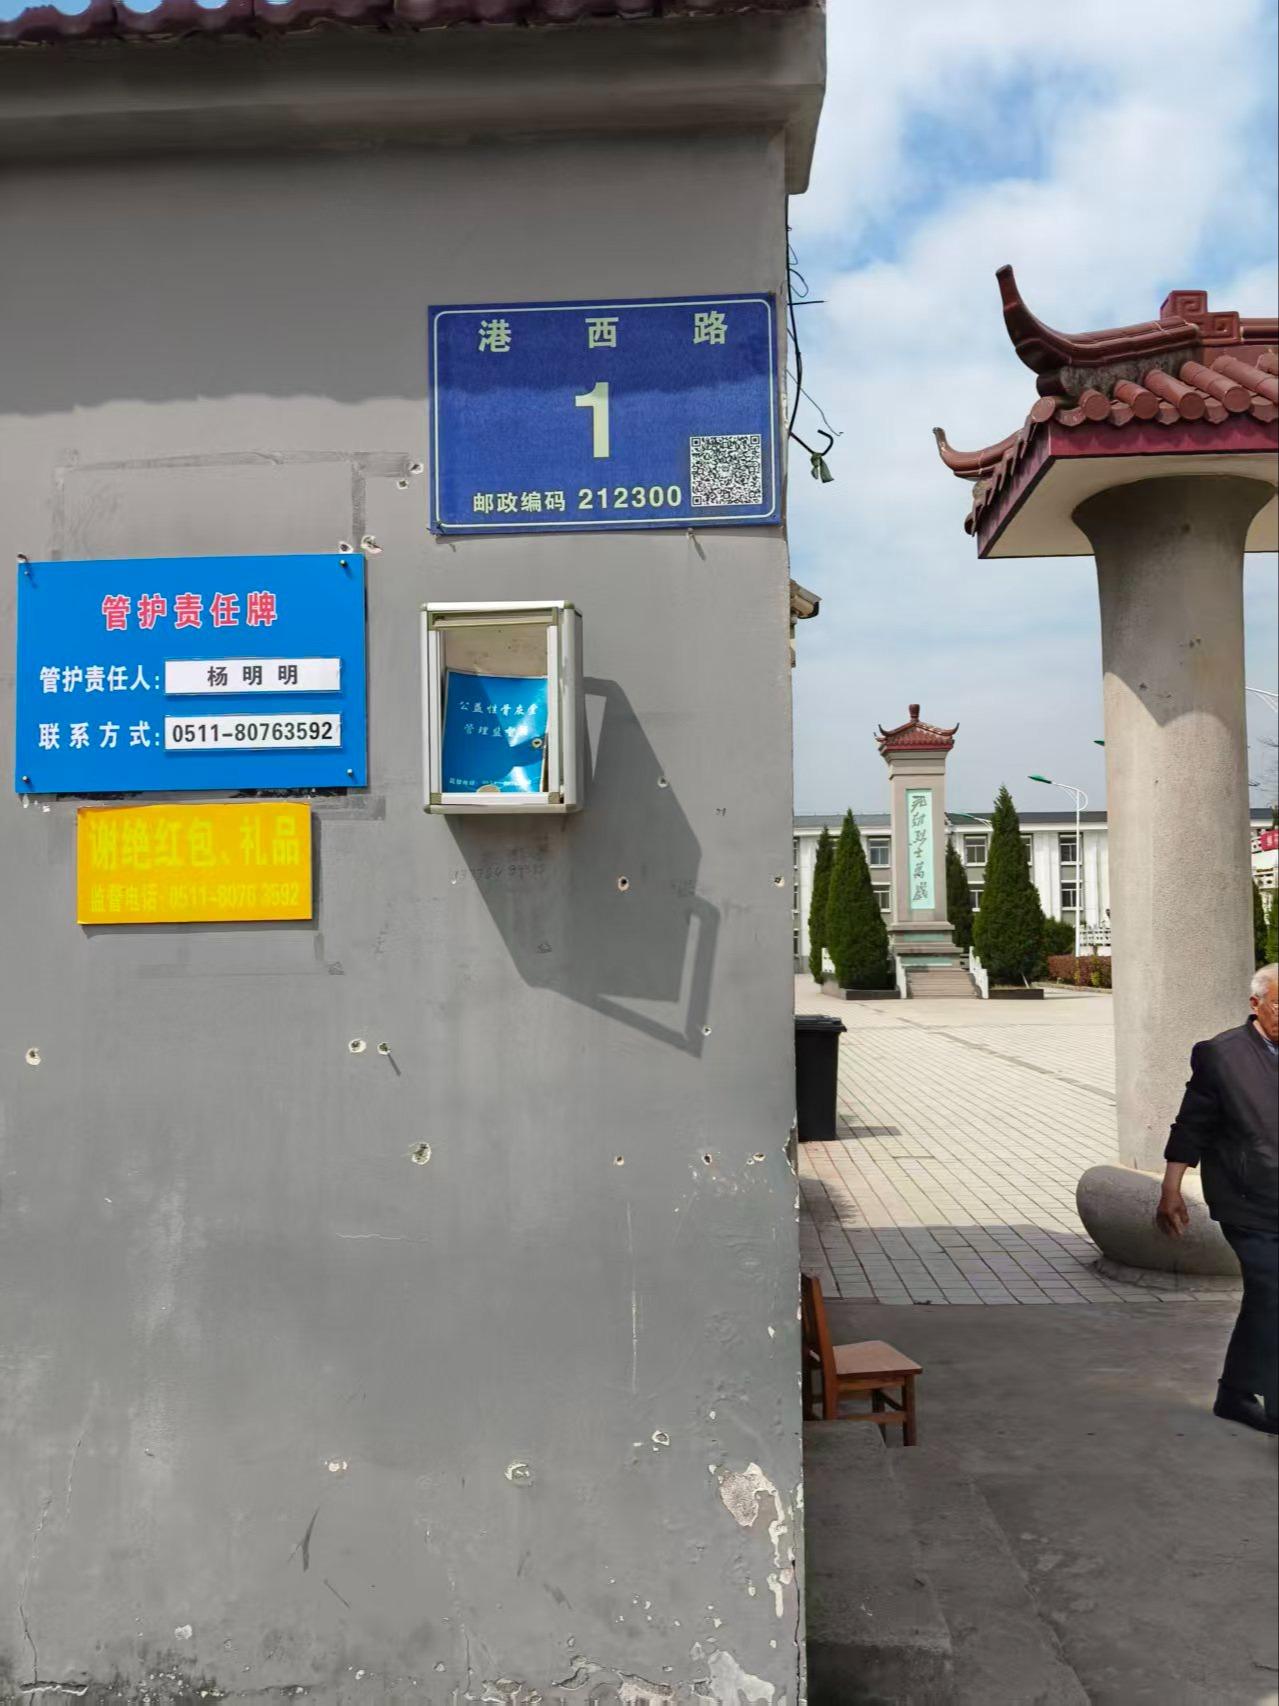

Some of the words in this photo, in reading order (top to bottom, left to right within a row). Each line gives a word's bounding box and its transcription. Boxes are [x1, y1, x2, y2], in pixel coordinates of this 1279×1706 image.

[478, 311, 728, 352] 港西路
[575, 381, 610, 458] 1
[473, 490, 566, 514] 邮政编码
[578, 486, 682, 509] 212300
[101, 590, 279, 632] 管护责任牌
[207, 664, 299, 687] 杨明明
[172, 720, 333, 744] 0511-80763592
[89, 815, 301, 871] 谢绝红包、礼品
